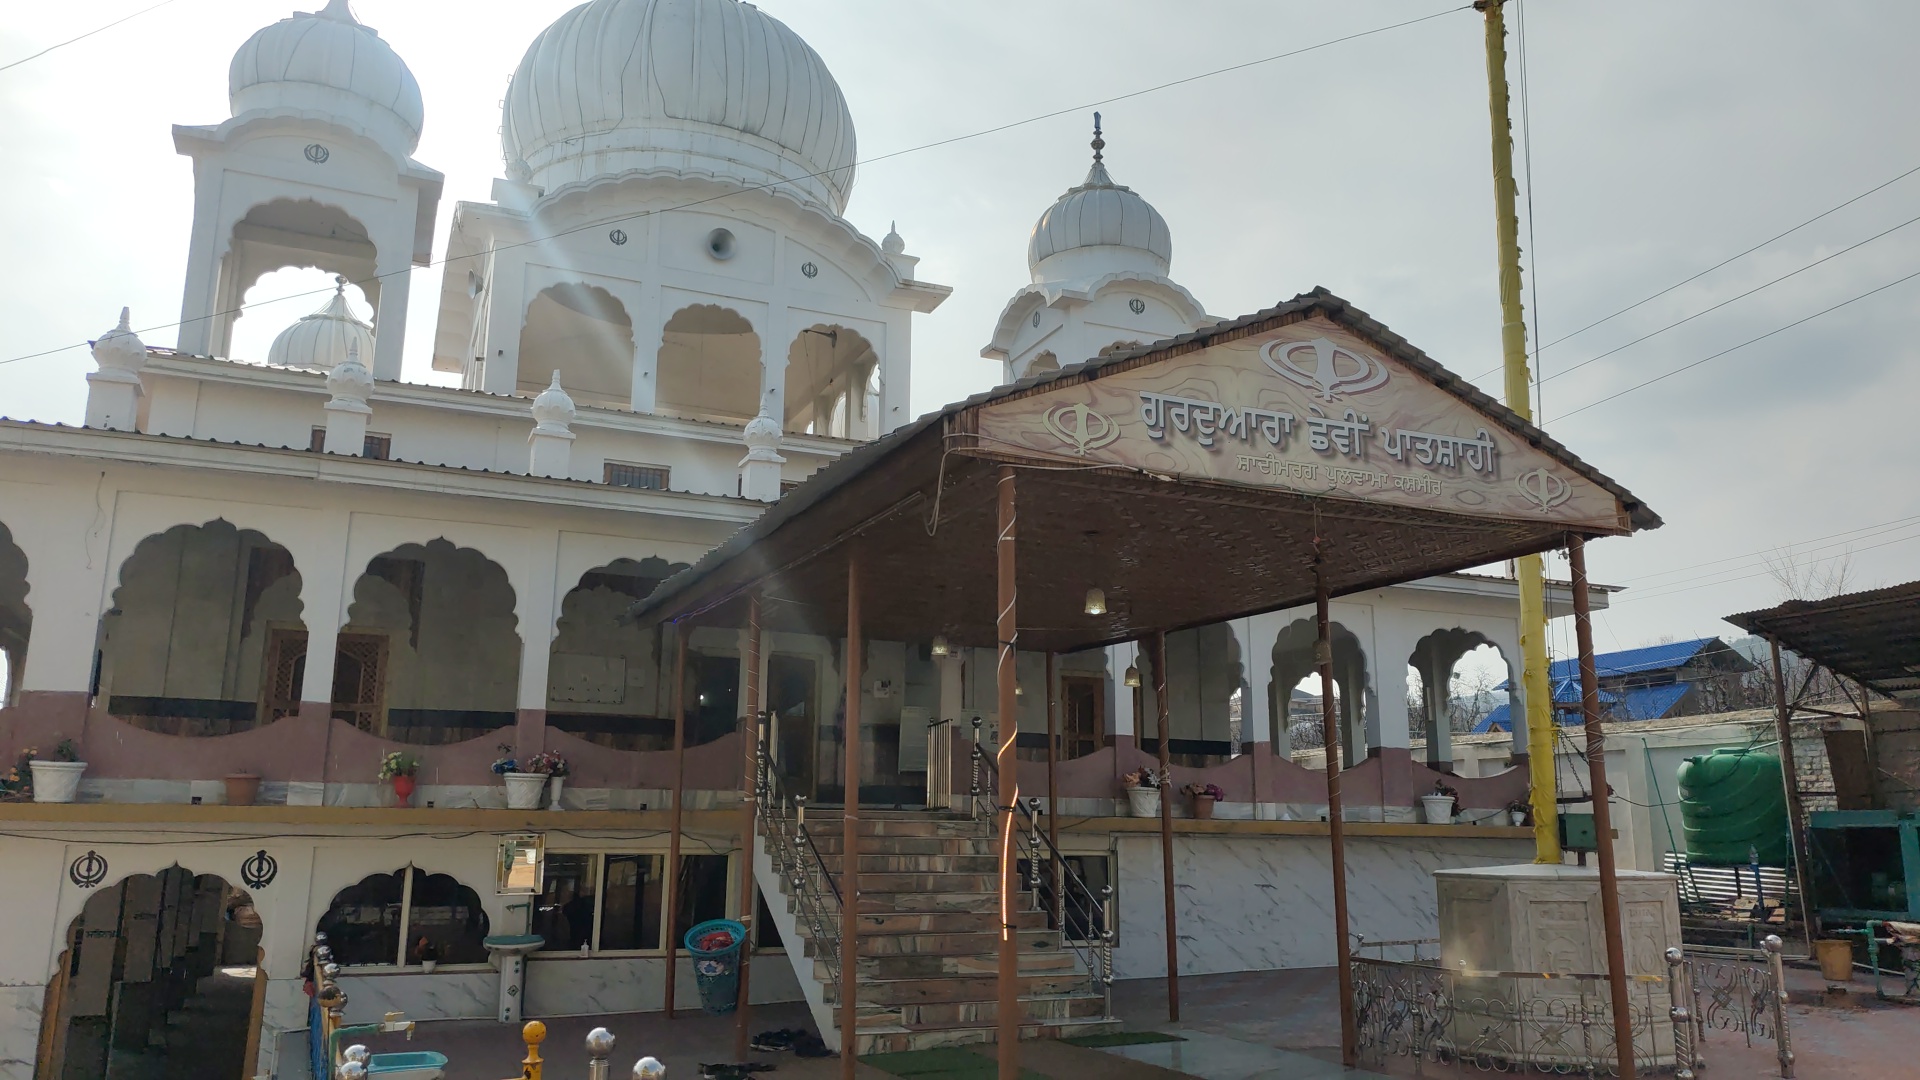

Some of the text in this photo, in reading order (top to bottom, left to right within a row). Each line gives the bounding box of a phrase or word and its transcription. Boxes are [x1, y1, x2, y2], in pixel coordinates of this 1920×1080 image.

[1140, 391, 1495, 472] ਗੁਰਦੁਆਰਾ ਛੇਵੀਂ ਪਾਤਸ਼ਾਹੀ
[1236, 452, 1318, 480] ਸ਼ਾਦੀਮਰਗ
[1393, 474, 1442, 495] ਕਸ਼ਮੀਰ
